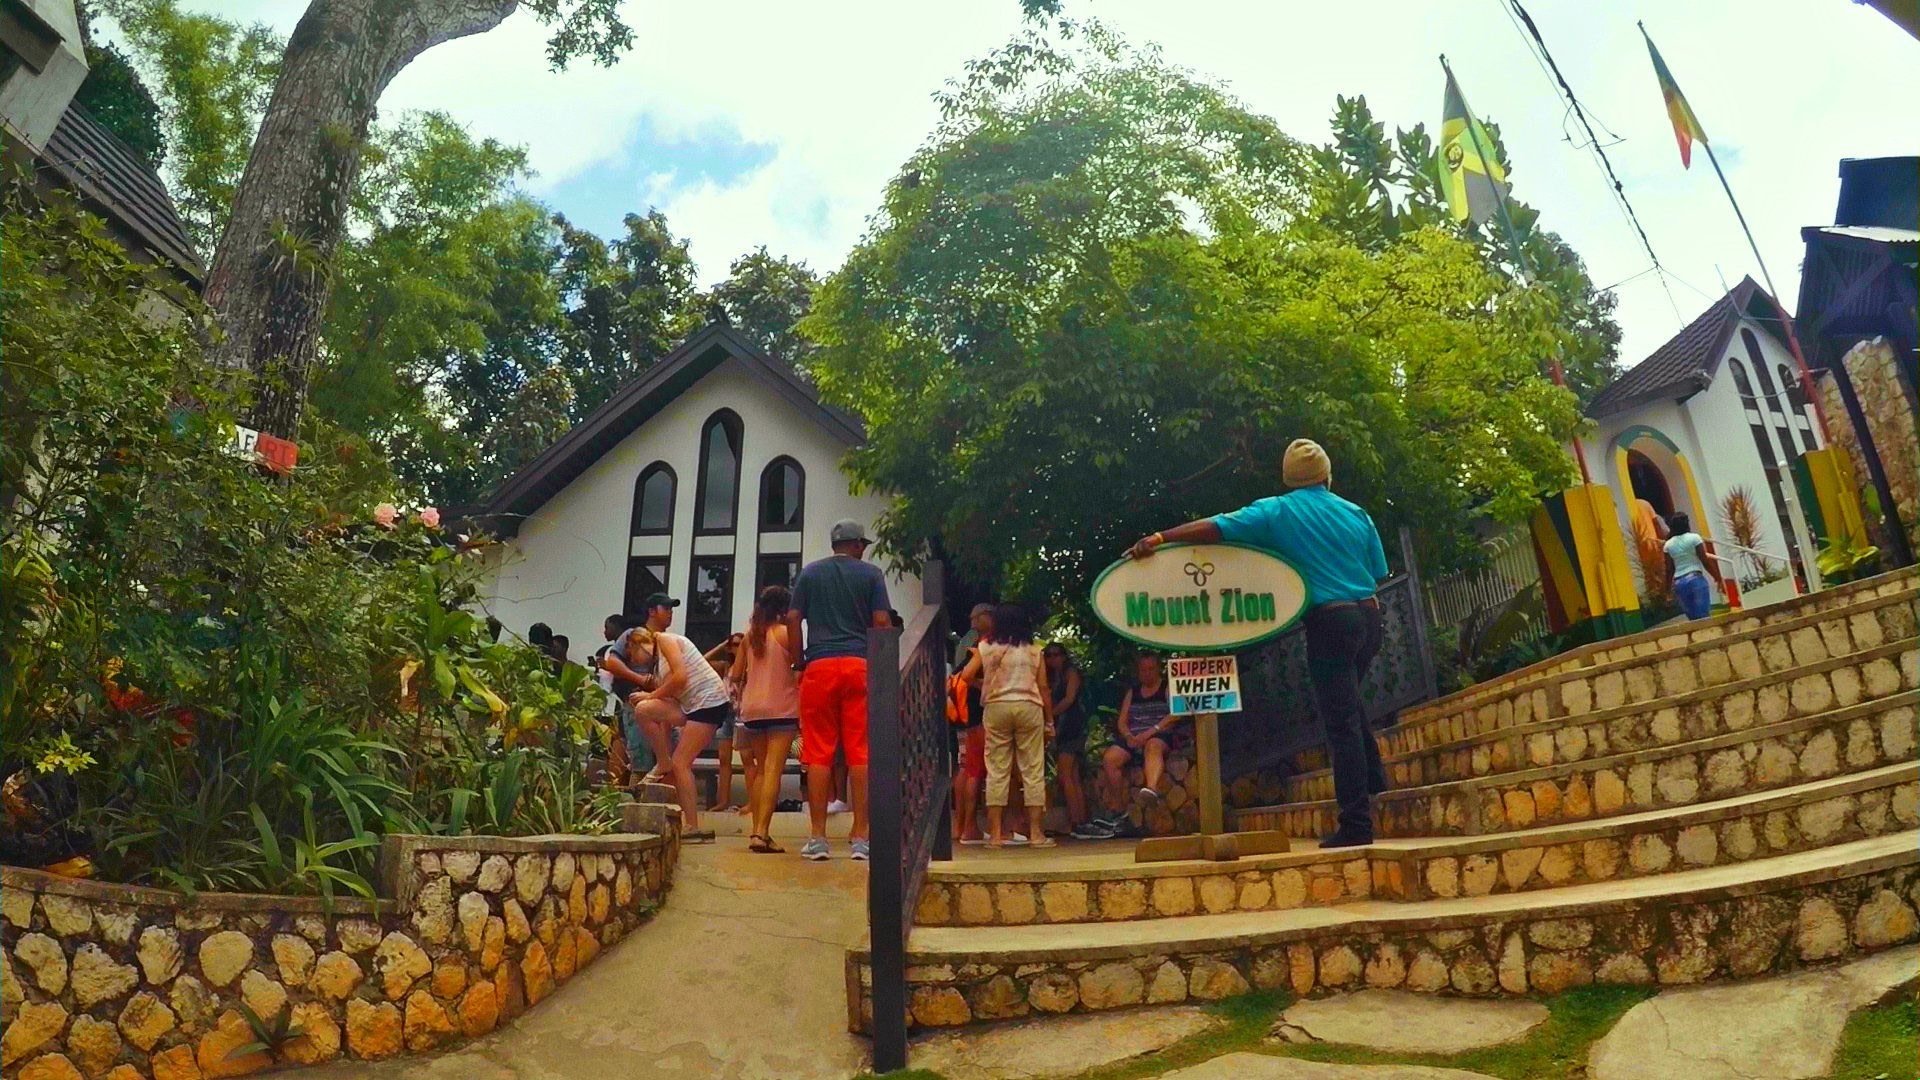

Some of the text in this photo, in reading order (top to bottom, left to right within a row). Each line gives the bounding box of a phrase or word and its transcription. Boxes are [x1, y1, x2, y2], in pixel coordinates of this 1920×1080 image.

[1125, 587, 1276, 627] Mount Zion
[1171, 659, 1233, 677] SLIPPERY
[1175, 676, 1231, 694] WHEN
[1184, 694, 1225, 711] WET
